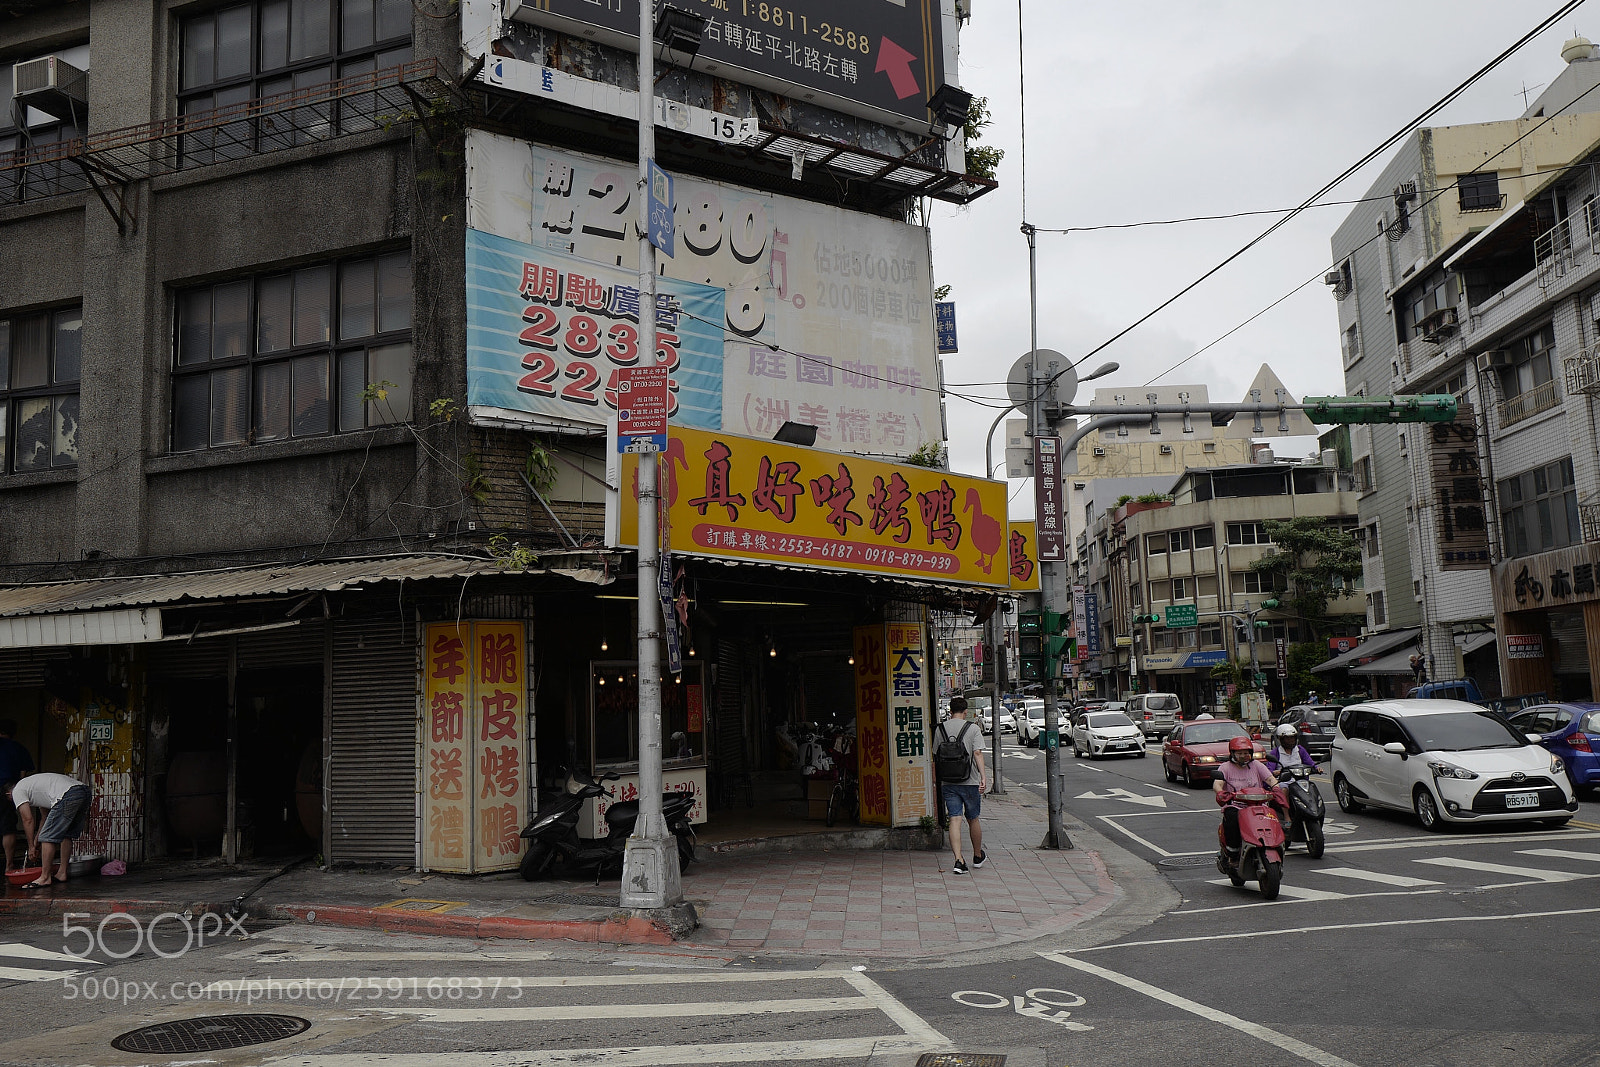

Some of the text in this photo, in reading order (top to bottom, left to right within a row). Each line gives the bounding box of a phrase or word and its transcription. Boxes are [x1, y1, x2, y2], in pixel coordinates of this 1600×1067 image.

[637, 4, 858, 83] 右轉延平北路左轉
[519, 305, 682, 374] 2835
[747, 346, 922, 396] 庭園咖啡
[688, 440, 963, 550] 真好味烤鴨
[92, 728, 110, 739] 219
[430, 634, 466, 861] 年節送禮
[480, 632, 521, 858] 脆皮烤鴨
[858, 636, 887, 817] 北平烤鴨
